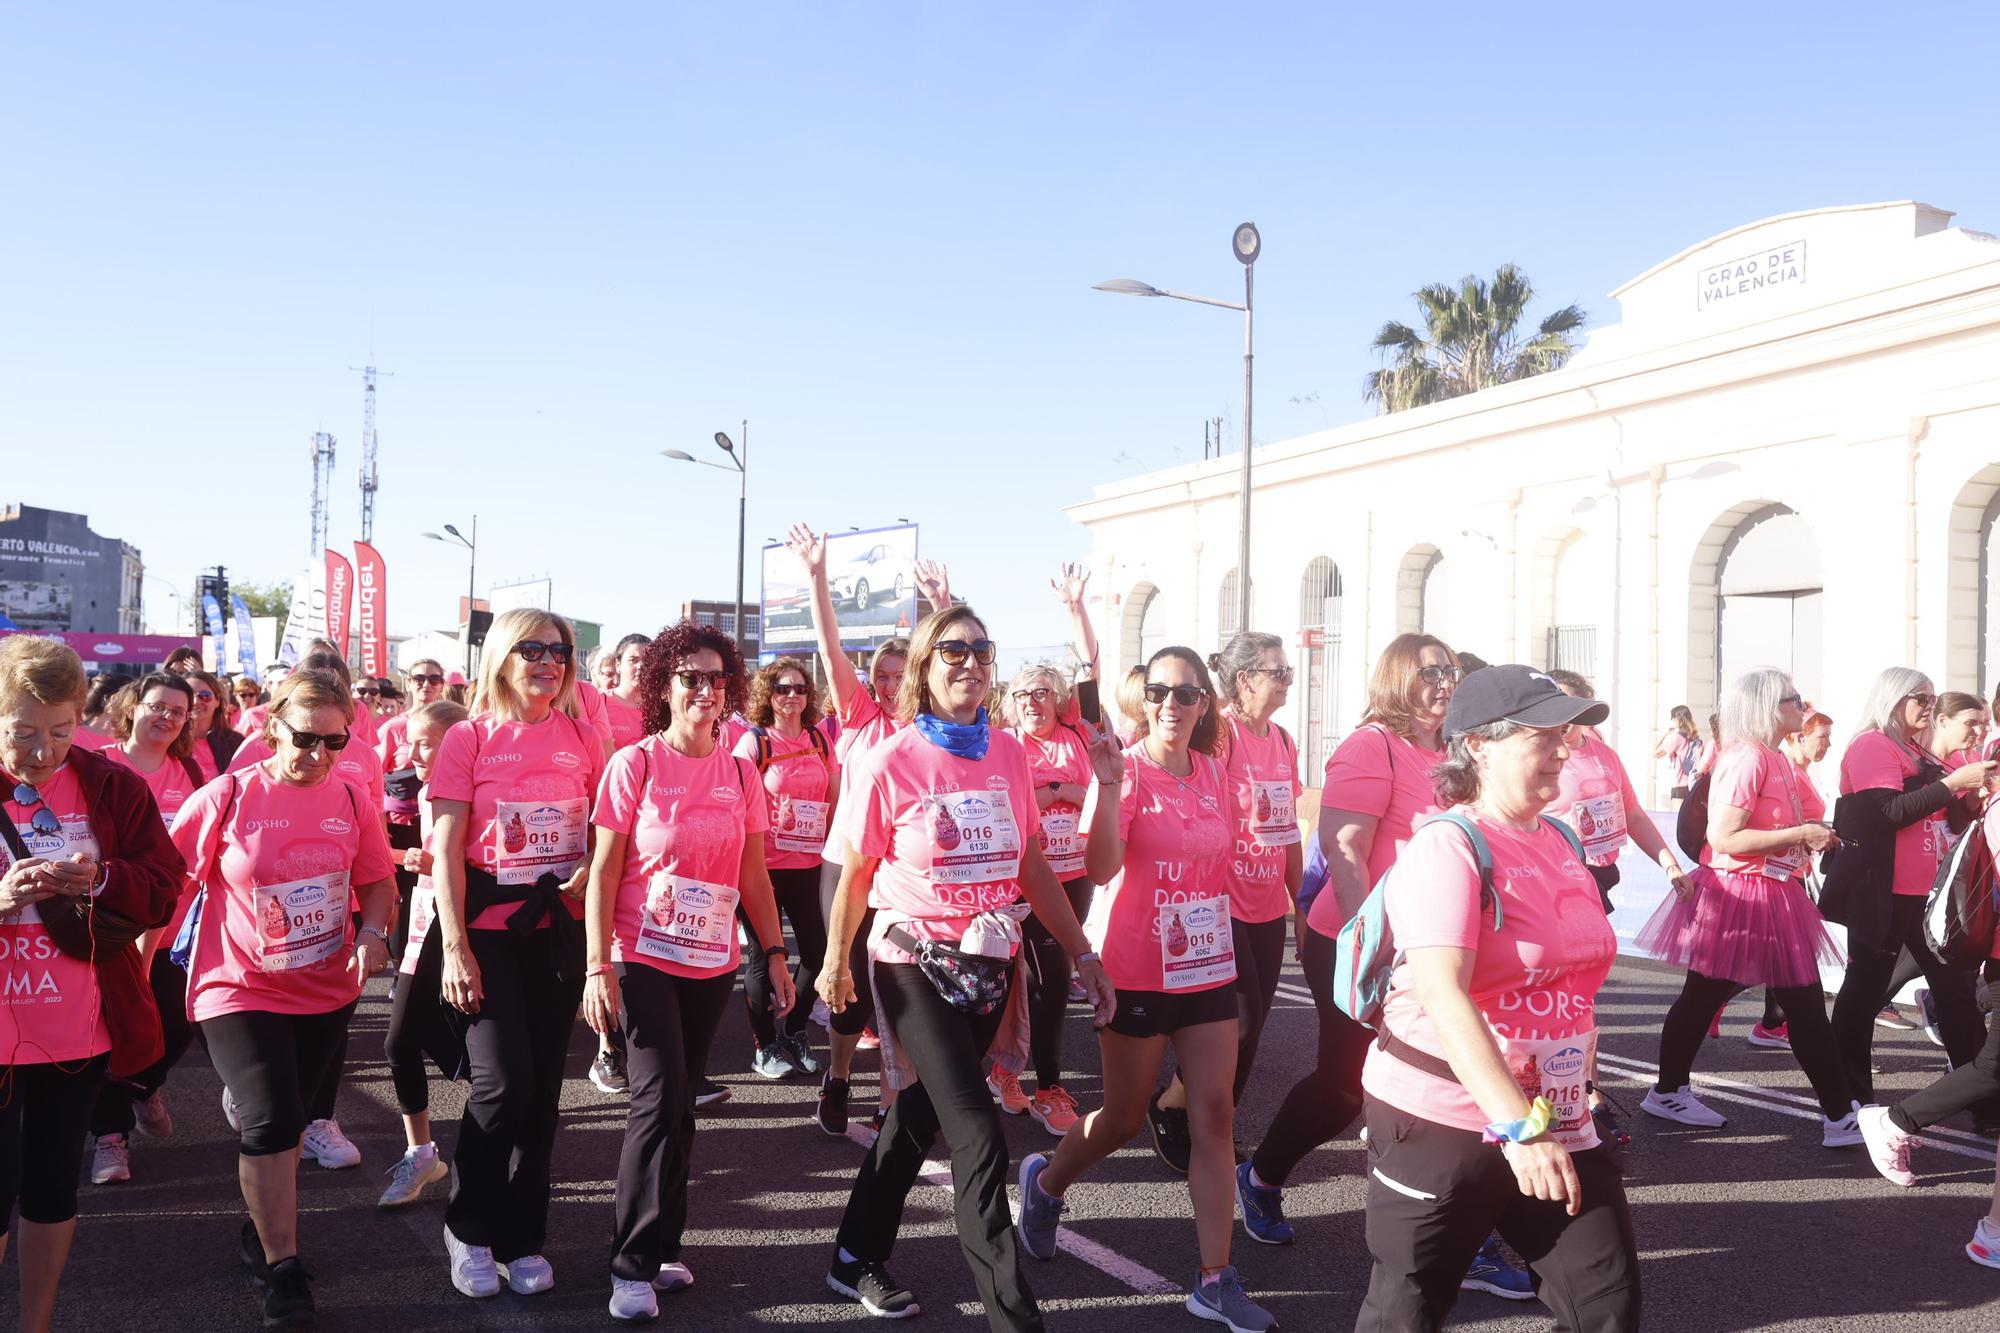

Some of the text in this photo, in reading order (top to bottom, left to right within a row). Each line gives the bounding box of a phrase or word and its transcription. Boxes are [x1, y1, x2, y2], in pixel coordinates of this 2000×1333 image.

[1708, 249, 1795, 285] GRAO DE
[1704, 266, 1798, 302] VALENCIA
[481, 753, 522, 765] OYSHO
[650, 785, 687, 796] OYSHO
[957, 807, 989, 816] ASTURIANA
[1272, 806, 1289, 816] 016
[246, 819, 290, 830] OYSHO
[530, 814, 563, 823] ASTURIANA
[1597, 817, 1614, 828] 016
[797, 820, 814, 830] 016
[529, 831, 560, 844] 016
[963, 826, 993, 841] 016
[969, 842, 989, 852] 6130
[1050, 836, 1071, 846] 016
[535, 846, 554, 854] 1044
[507, 870, 534, 879] OYSHO
[940, 869, 972, 879] OYSHO
[1155, 860, 1182, 882] TU
[1234, 860, 1280, 879] SUMA
[289, 892, 325, 905] ASTURIANA
[680, 892, 712, 906] ASTURIANA
[1154, 888, 1222, 908] DOR
[293, 909, 325, 927] 016
[676, 911, 707, 928] 016
[1187, 915, 1214, 925] ASTURIANA
[301, 925, 321, 937] 3034
[680, 927, 699, 938] 1043
[650, 932, 676, 944] CARRERA
[1190, 932, 1214, 947] 016
[0, 935, 61, 961] RS
[273, 940, 302, 952] CARRERA
[646, 942, 675, 955] OYSHO
[1195, 947, 1211, 957] 6062
[272, 953, 304, 965] OYSHO
[3, 969, 59, 996] MA
[1171, 972, 1196, 982] OYSHO
[1524, 967, 1561, 987] TU
[1548, 1058, 1583, 1071] ASTURIANA
[1545, 1084, 1580, 1103] 016
